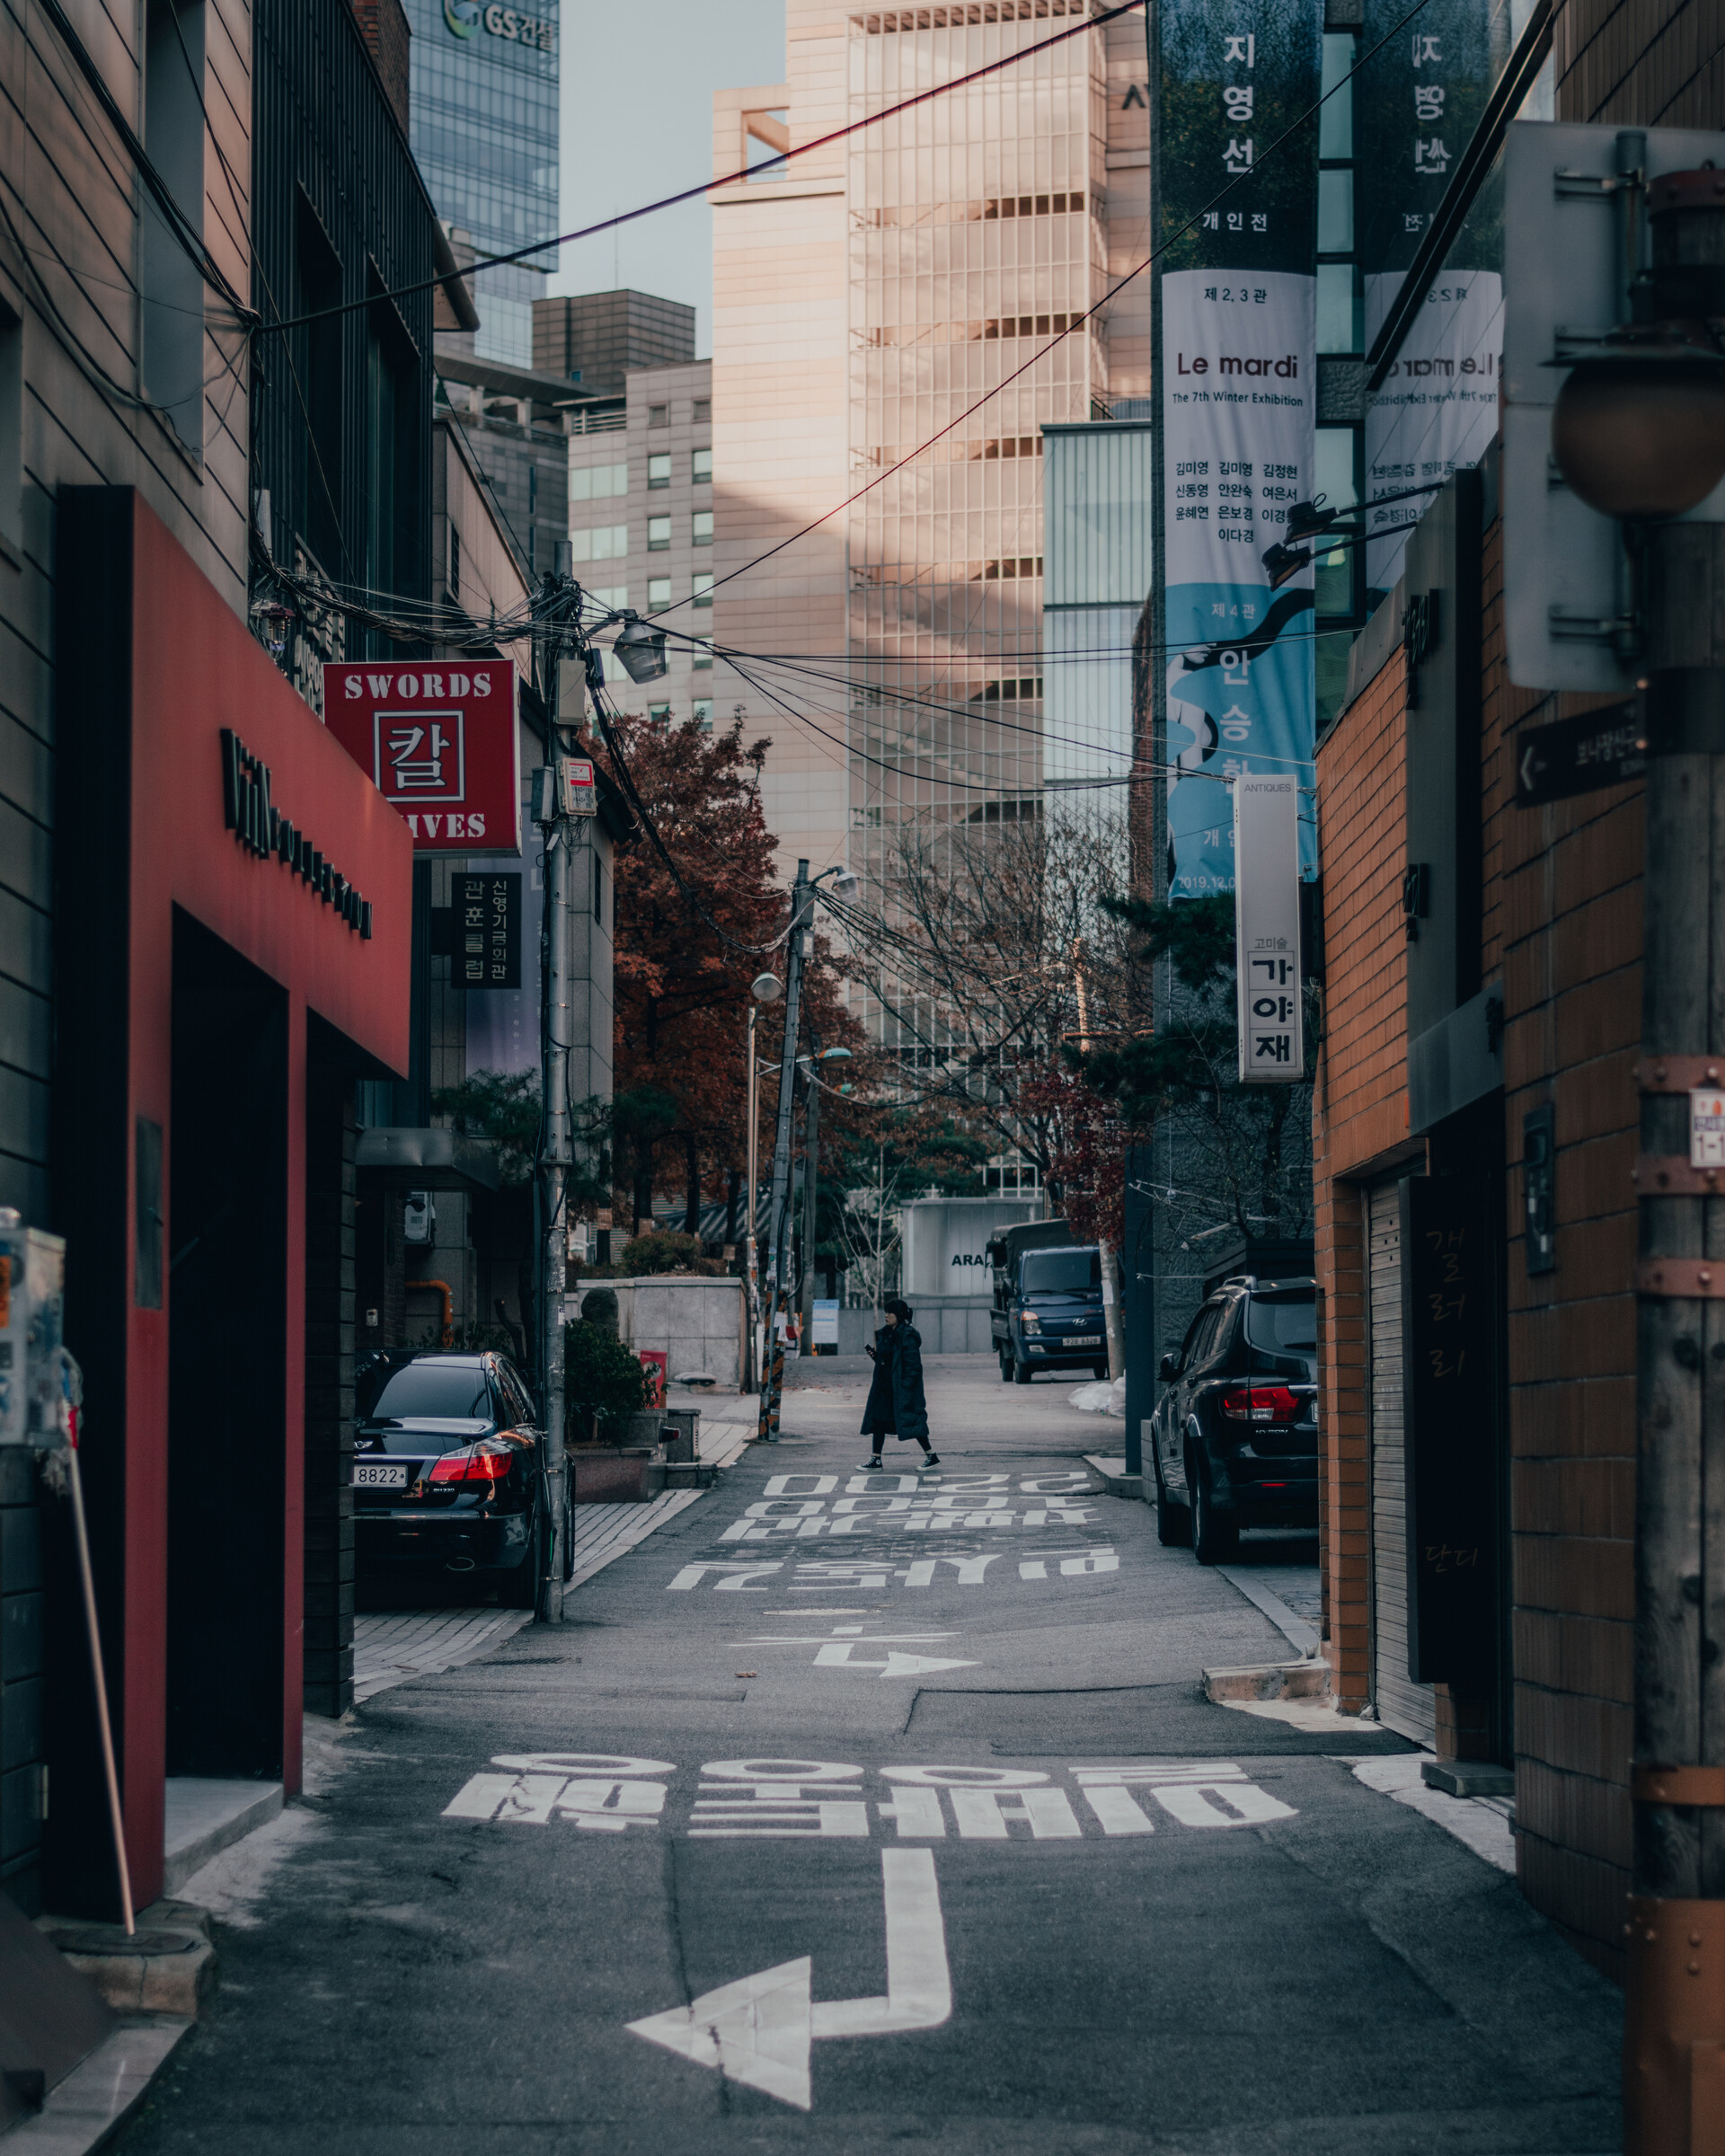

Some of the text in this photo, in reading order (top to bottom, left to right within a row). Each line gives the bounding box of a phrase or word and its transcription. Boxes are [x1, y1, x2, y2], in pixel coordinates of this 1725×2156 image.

[483, 4, 553, 53] GS건설
[1221, 33, 1256, 174] 지영선
[1178, 352, 1298, 379] Le mardi
[1172, 391, 1304, 408] The 7th Winter Exhibition
[1175, 461, 1209, 476] 김미영
[1218, 461, 1253, 477] 김미영
[1261, 508, 1288, 524] 이경
[344, 671, 493, 700] SWORDS
[387, 721, 451, 791] 칼
[1243, 782, 1292, 793] ANTIQUES
[404, 812, 487, 839] IVES
[464, 879, 486, 980] 관훈클럽
[491, 879, 508, 980] 신영기금회관
[1254, 937, 1287, 950] 고미술
[1252, 959, 1294, 1063] 가야재
[358, 1468, 398, 1484] 8822
